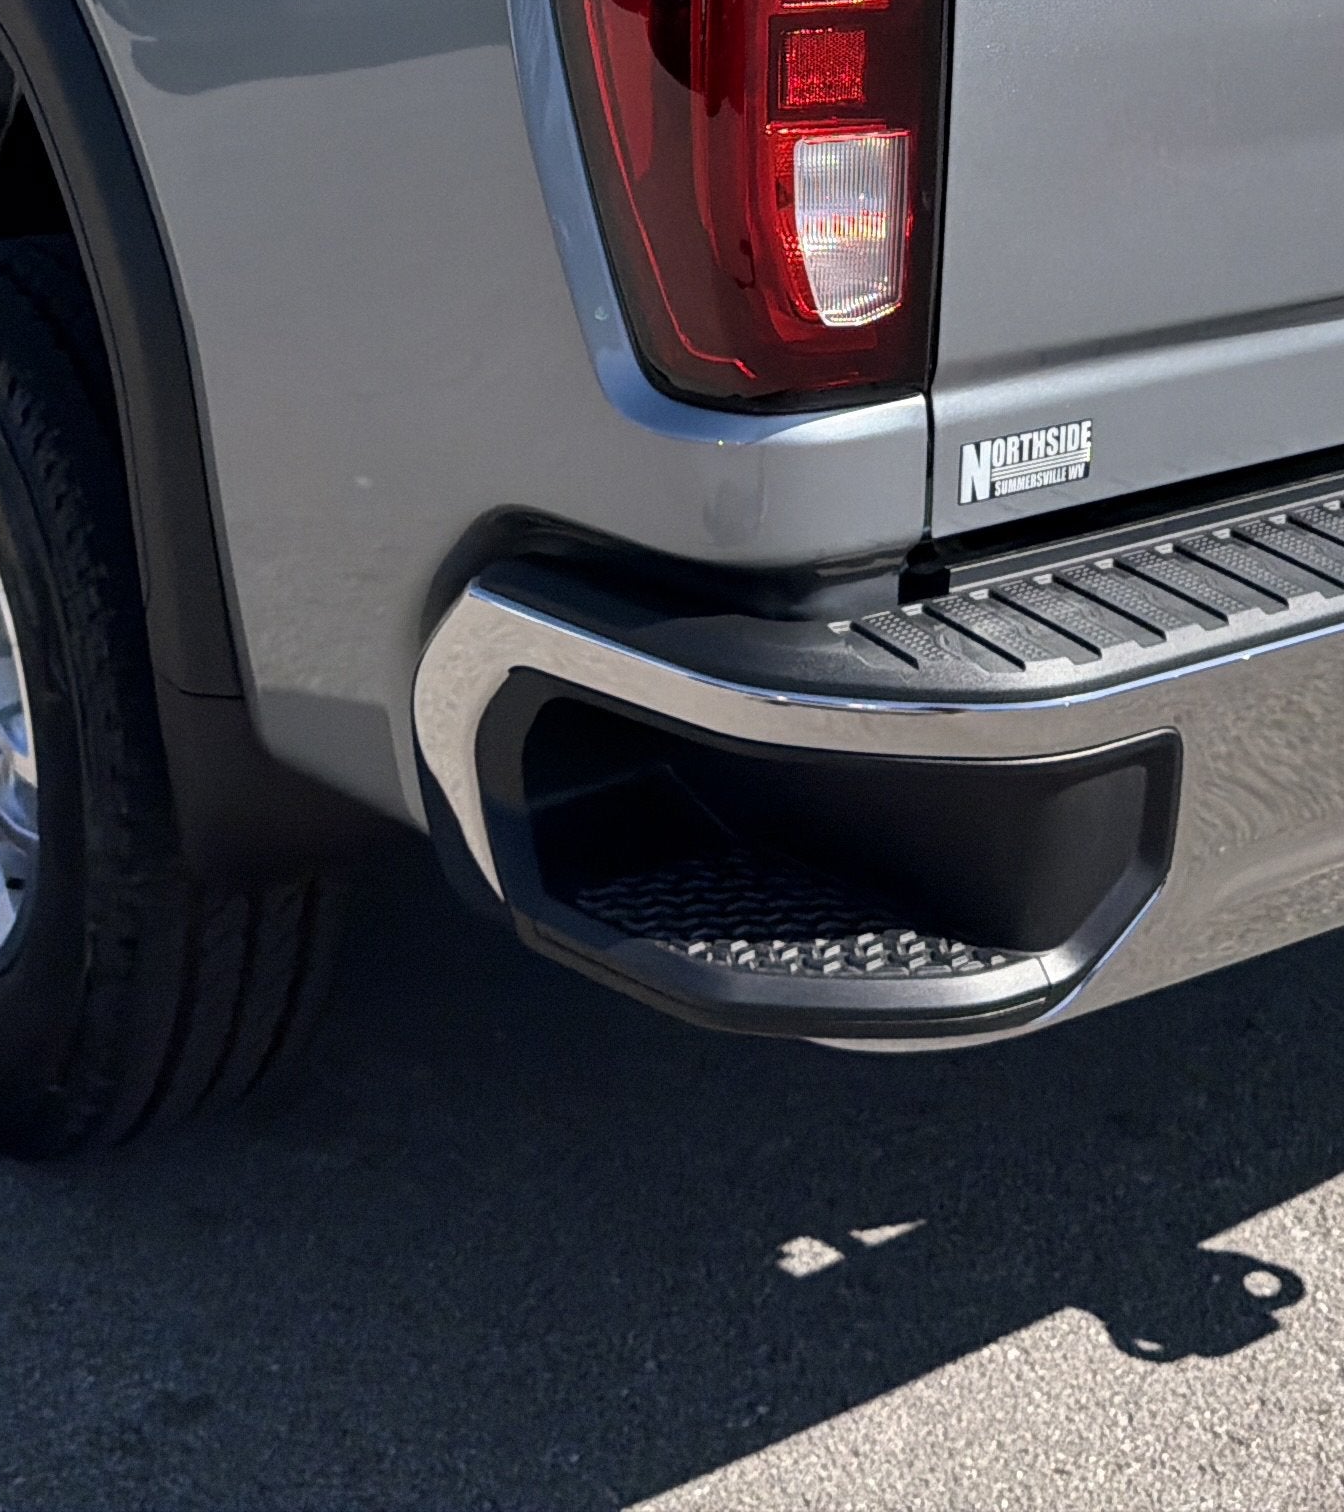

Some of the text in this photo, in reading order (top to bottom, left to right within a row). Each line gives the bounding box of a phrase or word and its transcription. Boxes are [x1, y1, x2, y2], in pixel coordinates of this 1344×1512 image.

[960, 420, 1092, 504] NORTHSIDE
[995, 463, 1085, 497] SUMMERSVILLE WV
